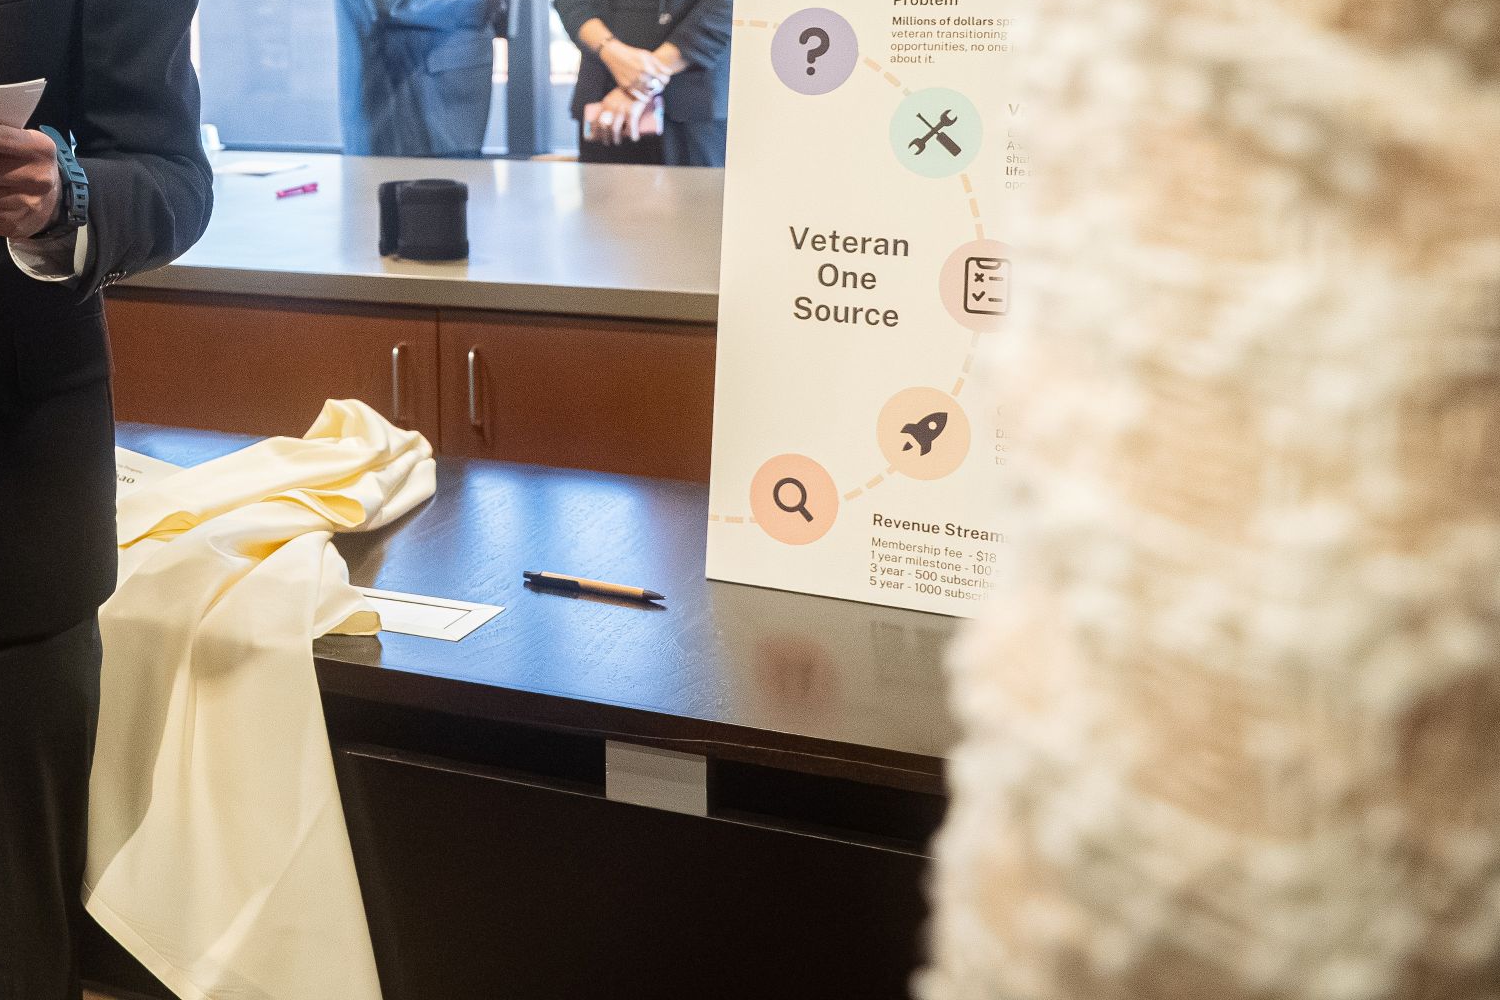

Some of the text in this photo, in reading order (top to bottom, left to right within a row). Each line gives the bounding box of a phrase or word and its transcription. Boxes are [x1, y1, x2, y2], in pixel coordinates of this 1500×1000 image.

[892, 16, 937, 26] Millions
[939, 16, 951, 26] of
[953, 16, 994, 26] dollars
[891, 29, 1008, 41] veteran transitioning
[890, 41, 968, 52] opportunities,
[970, 43, 985, 52] no
[987, 43, 1008, 52] one
[890, 54, 921, 64] about
[1005, 166, 1026, 176] life
[788, 225, 909, 257] Veteran
[817, 262, 877, 290] One
[793, 296, 899, 328] Source
[872, 513, 1010, 543] Revenue Stream
[871, 537, 941, 557] Membership
[944, 546, 963, 559] fee
[870, 562, 877, 573] 3
[880, 565, 905, 577] year
[915, 569, 937, 582] 500
[878, 552, 902, 562] year
[905, 556, 961, 572] milestone
[869, 575, 877, 586] 5
[879, 578, 905, 589] year
[915, 582, 942, 596] 1000
